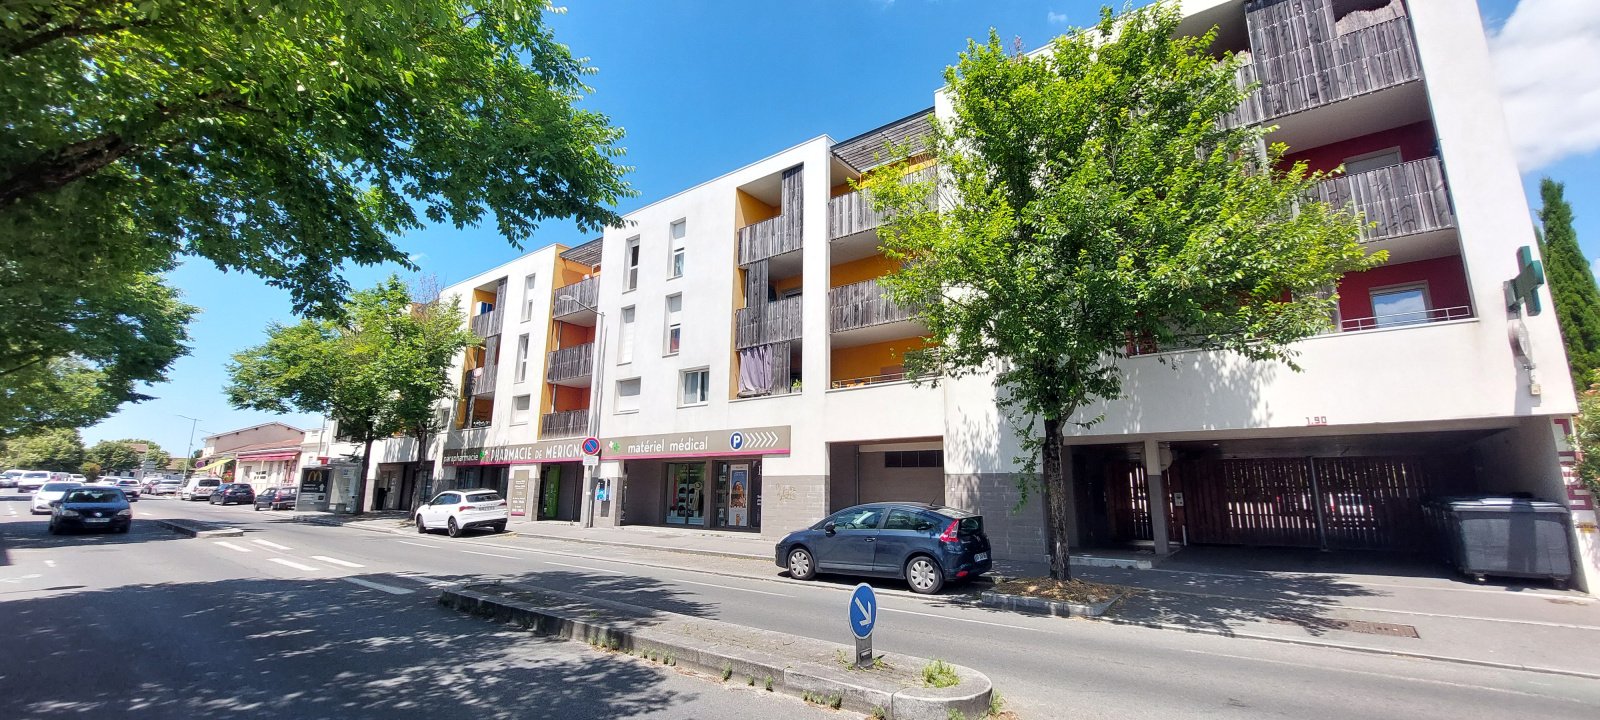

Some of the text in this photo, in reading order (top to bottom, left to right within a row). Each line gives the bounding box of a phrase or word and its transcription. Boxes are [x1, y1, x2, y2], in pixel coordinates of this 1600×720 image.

[1305, 416, 1327, 425] 1.90
[628, 436, 708, 454] matériel médical
[733, 435, 740, 448] P
[443, 443, 584, 464] parapharmacie PHARMACIE DE MERIGN
